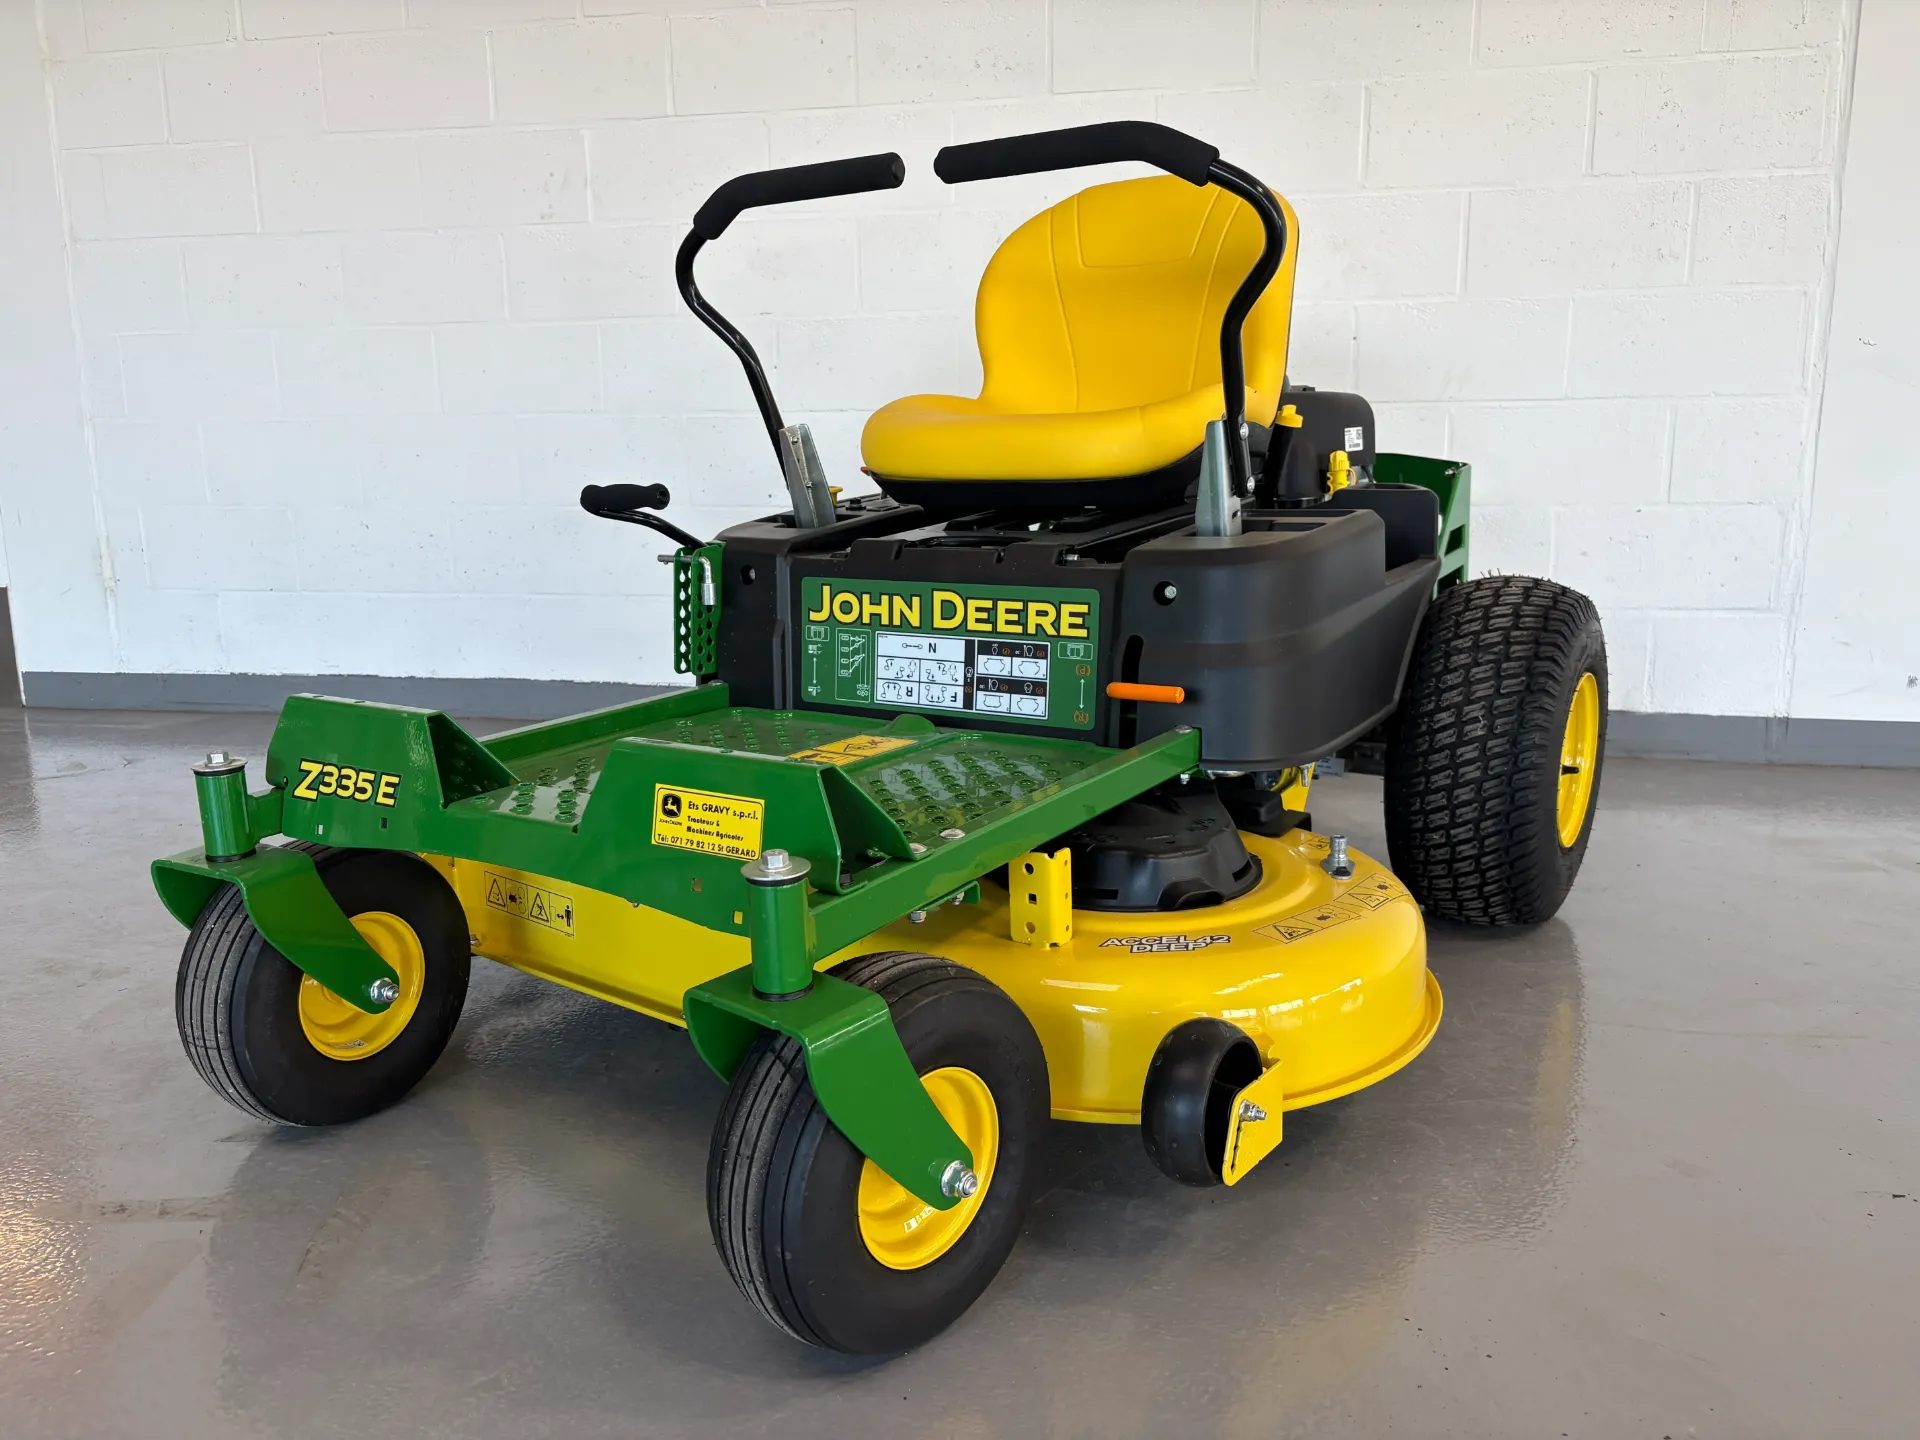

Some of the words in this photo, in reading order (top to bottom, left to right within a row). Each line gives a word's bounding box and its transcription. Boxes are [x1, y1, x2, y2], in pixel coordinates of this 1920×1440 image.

[808, 584, 921, 628] JOHN
[932, 588, 1090, 638] DEERE
[688, 801, 699, 810] Ets
[702, 803, 730, 815] GRAVY
[732, 810, 758, 820] s.p.r.l.
[686, 826, 714, 837] Machines
[715, 831, 744, 842] Agricoles
[671, 836, 682, 845] 071
[685, 838, 694, 847] 79
[696, 840, 704, 849] 82
[707, 842, 715, 851] 12
[718, 843, 724, 852] St
[725, 845, 756, 858] GERARD
[1130, 942, 1207, 953] DEEP
